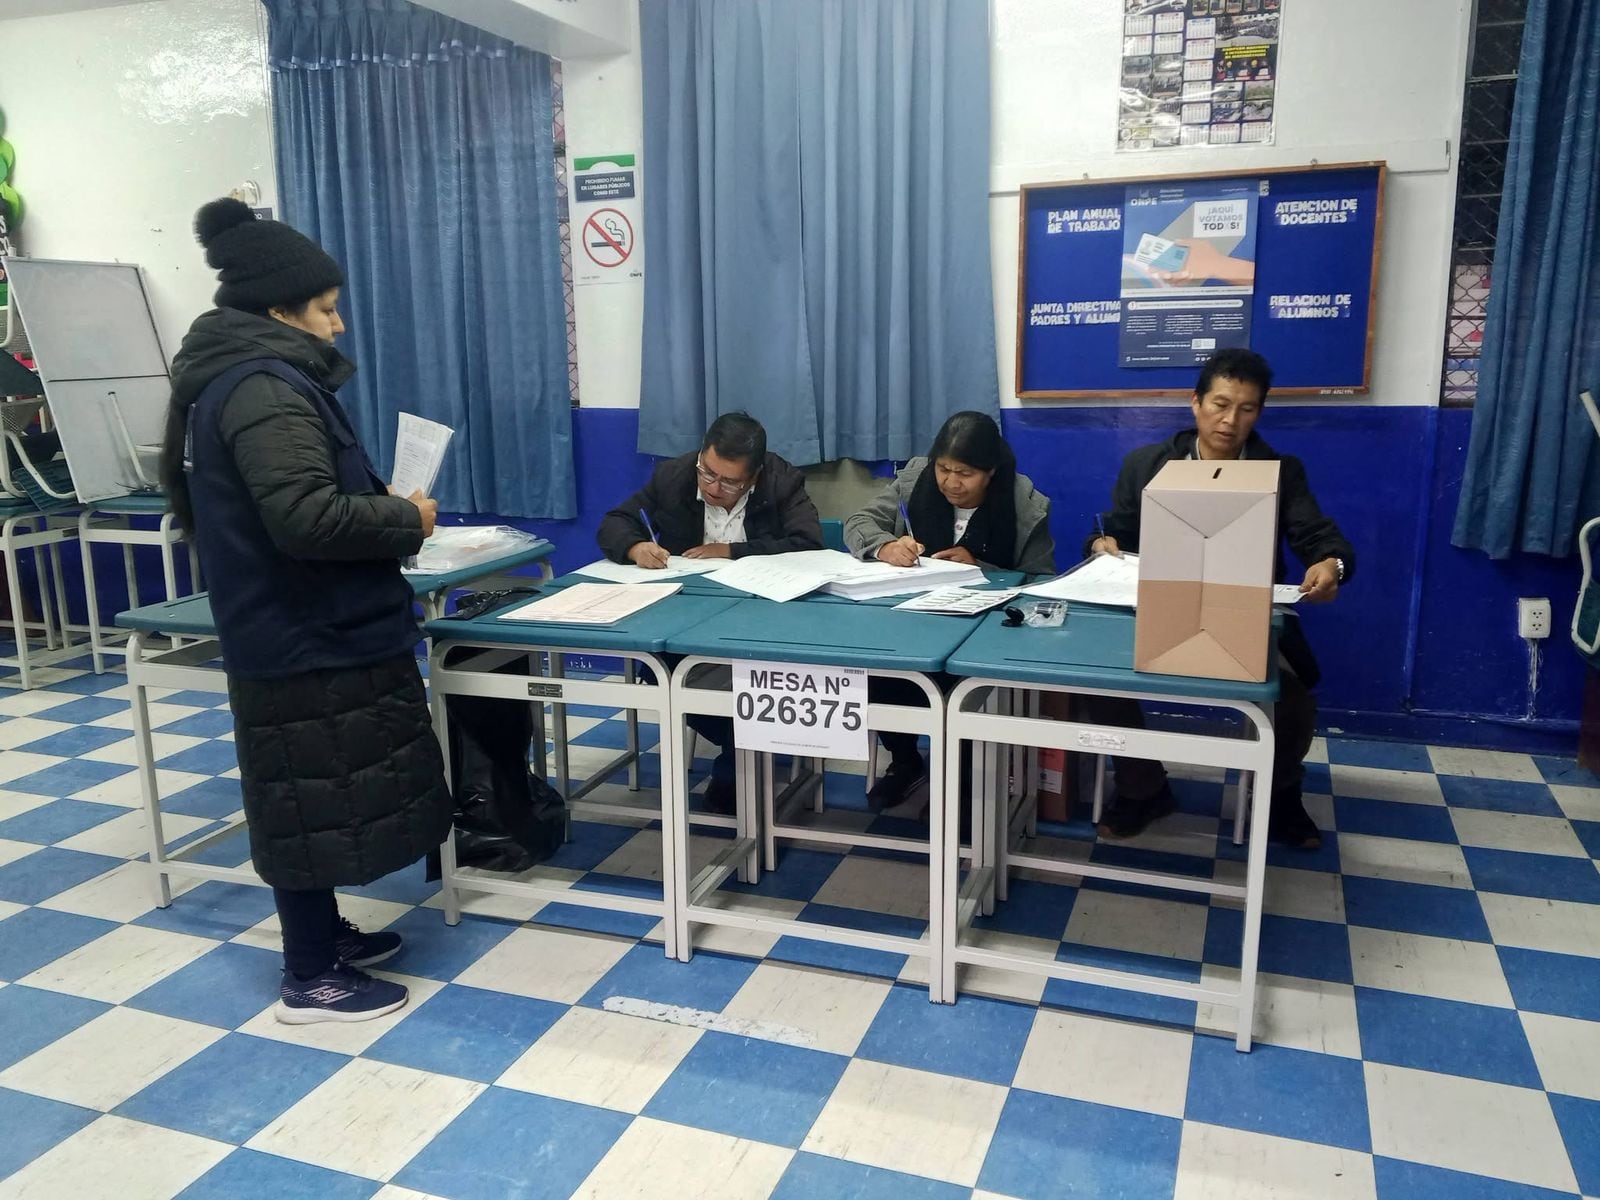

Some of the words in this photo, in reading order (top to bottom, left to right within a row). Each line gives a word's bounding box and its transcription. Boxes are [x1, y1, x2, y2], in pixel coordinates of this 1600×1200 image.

[1275, 200, 1339, 214] ATENCION
[1341, 199, 1358, 210] DE
[1048, 210, 1078, 222] PLAN
[1082, 208, 1121, 220] ANUAL
[1199, 214, 1243, 222] VOTAMOS
[1280, 211, 1348, 226] DOCENTES
[1047, 222, 1063, 234] DE
[1068, 220, 1121, 232] TRABAJO
[1270, 295, 1331, 306] RELACION
[1335, 294, 1352, 305] DE
[1031, 303, 1064, 314] JUNTA
[1278, 307, 1339, 318] ALUMNOS
[1031, 314, 1070, 326] PADRES
[1074, 314, 1081, 325] Y
[750, 669, 818, 693] MESA
[736, 691, 862, 731] 026375
